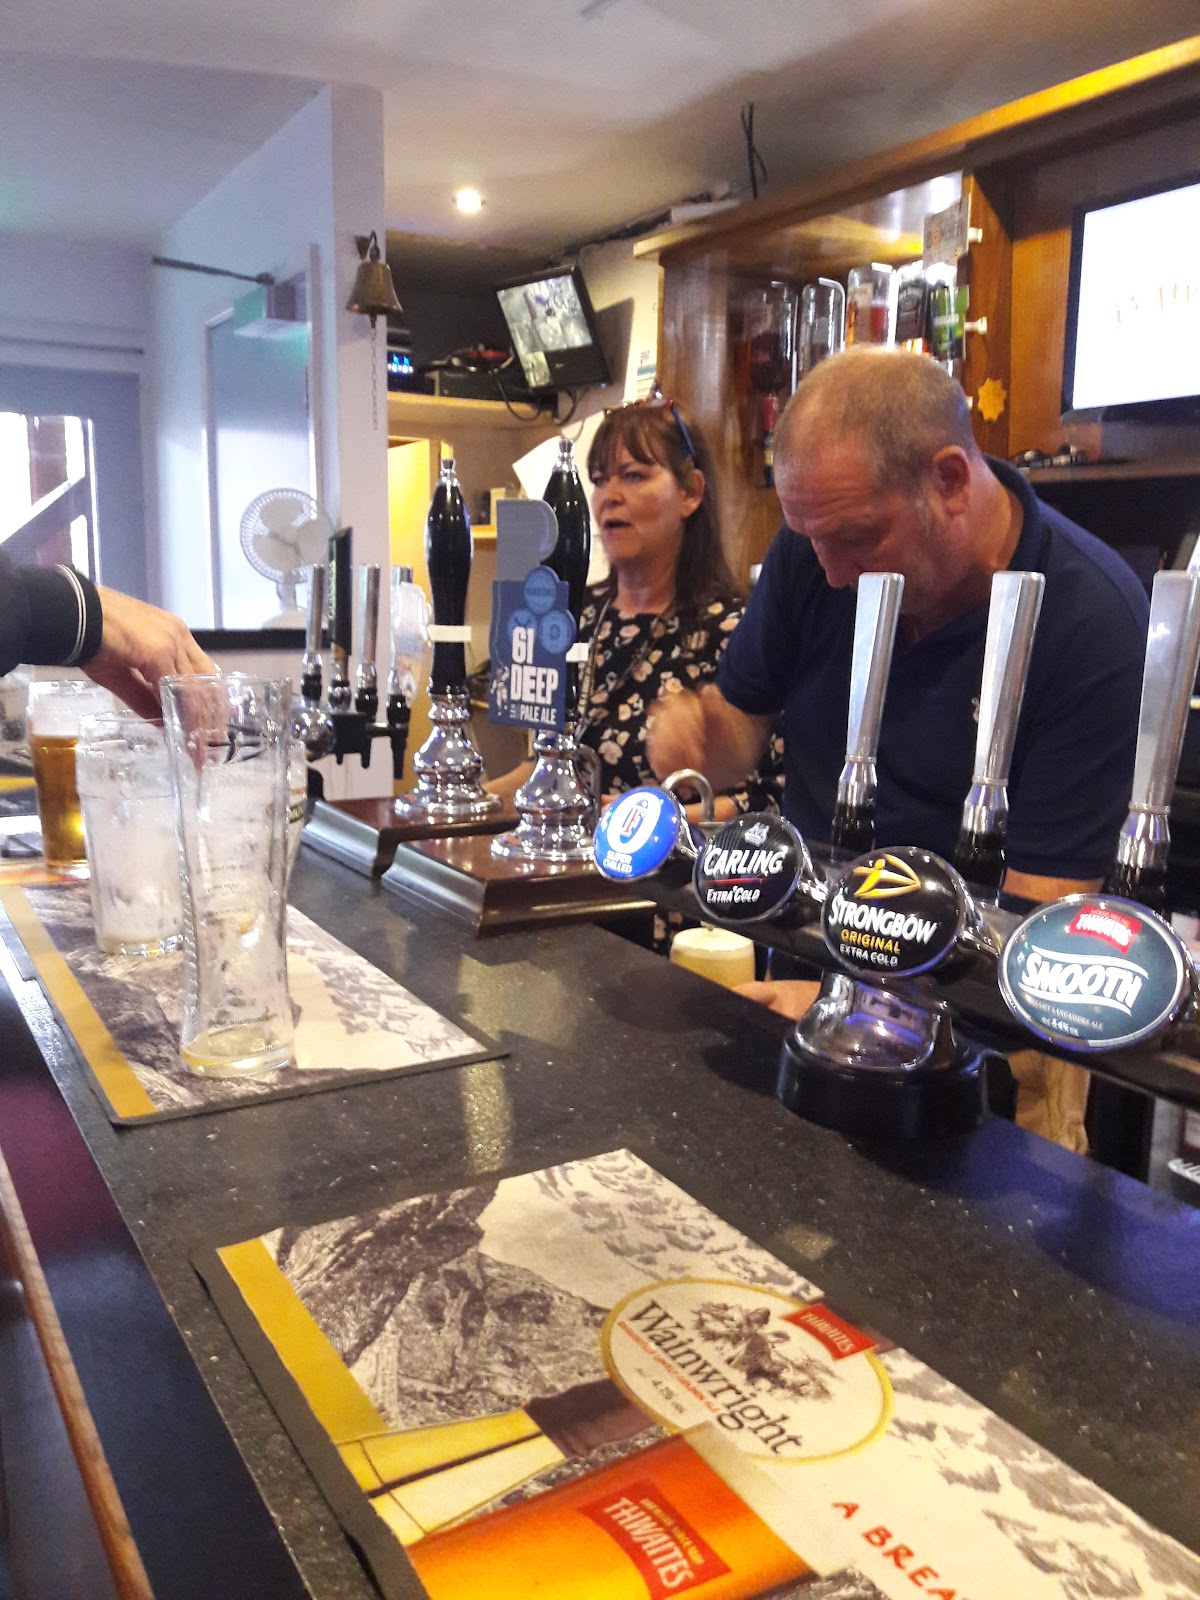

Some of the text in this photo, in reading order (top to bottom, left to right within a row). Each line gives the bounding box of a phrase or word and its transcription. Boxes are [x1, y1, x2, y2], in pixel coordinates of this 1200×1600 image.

[511, 626, 534, 664] 61
[510, 664, 558, 704] DEEP
[520, 704, 539, 722] PALE
[540, 707, 557, 725] ALE
[704, 848, 786, 876] CARLING
[707, 886, 760, 903] EXTRA COLD
[828, 893, 937, 944] STRONGBOW
[840, 944, 898, 967] EXTRA COLD
[841, 929, 900, 954] ORIGINAL
[1021, 952, 1143, 1008] SMOOTH
[629, 1300, 802, 1454] Wainwright
[832, 1502, 860, 1519] A
[603, 1496, 695, 1588] THWAITES
